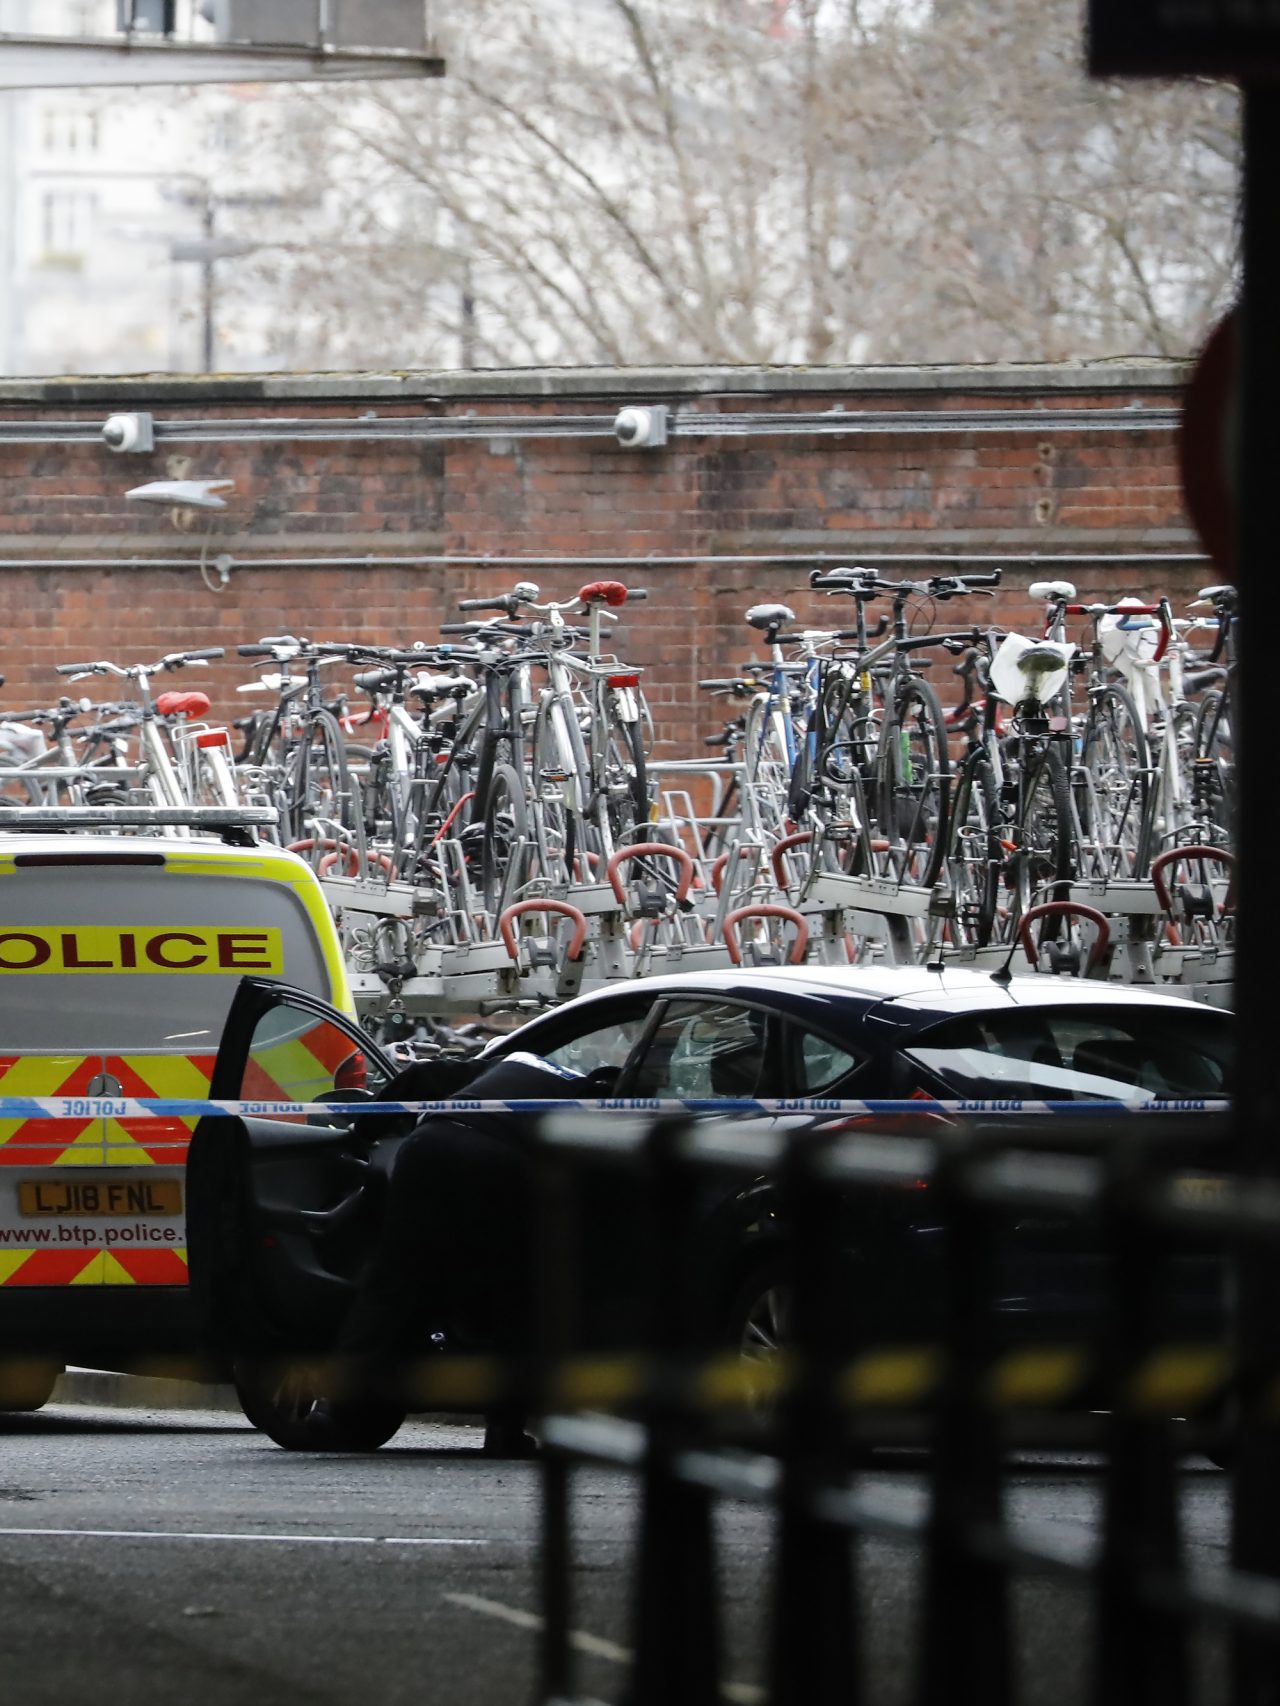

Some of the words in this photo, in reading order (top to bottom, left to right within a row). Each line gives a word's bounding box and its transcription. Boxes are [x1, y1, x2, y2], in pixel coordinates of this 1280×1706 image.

[62, 1100, 126, 1116] POLICE
[35, 1184, 100, 1213] LJ18
[108, 1183, 165, 1213] FNL
